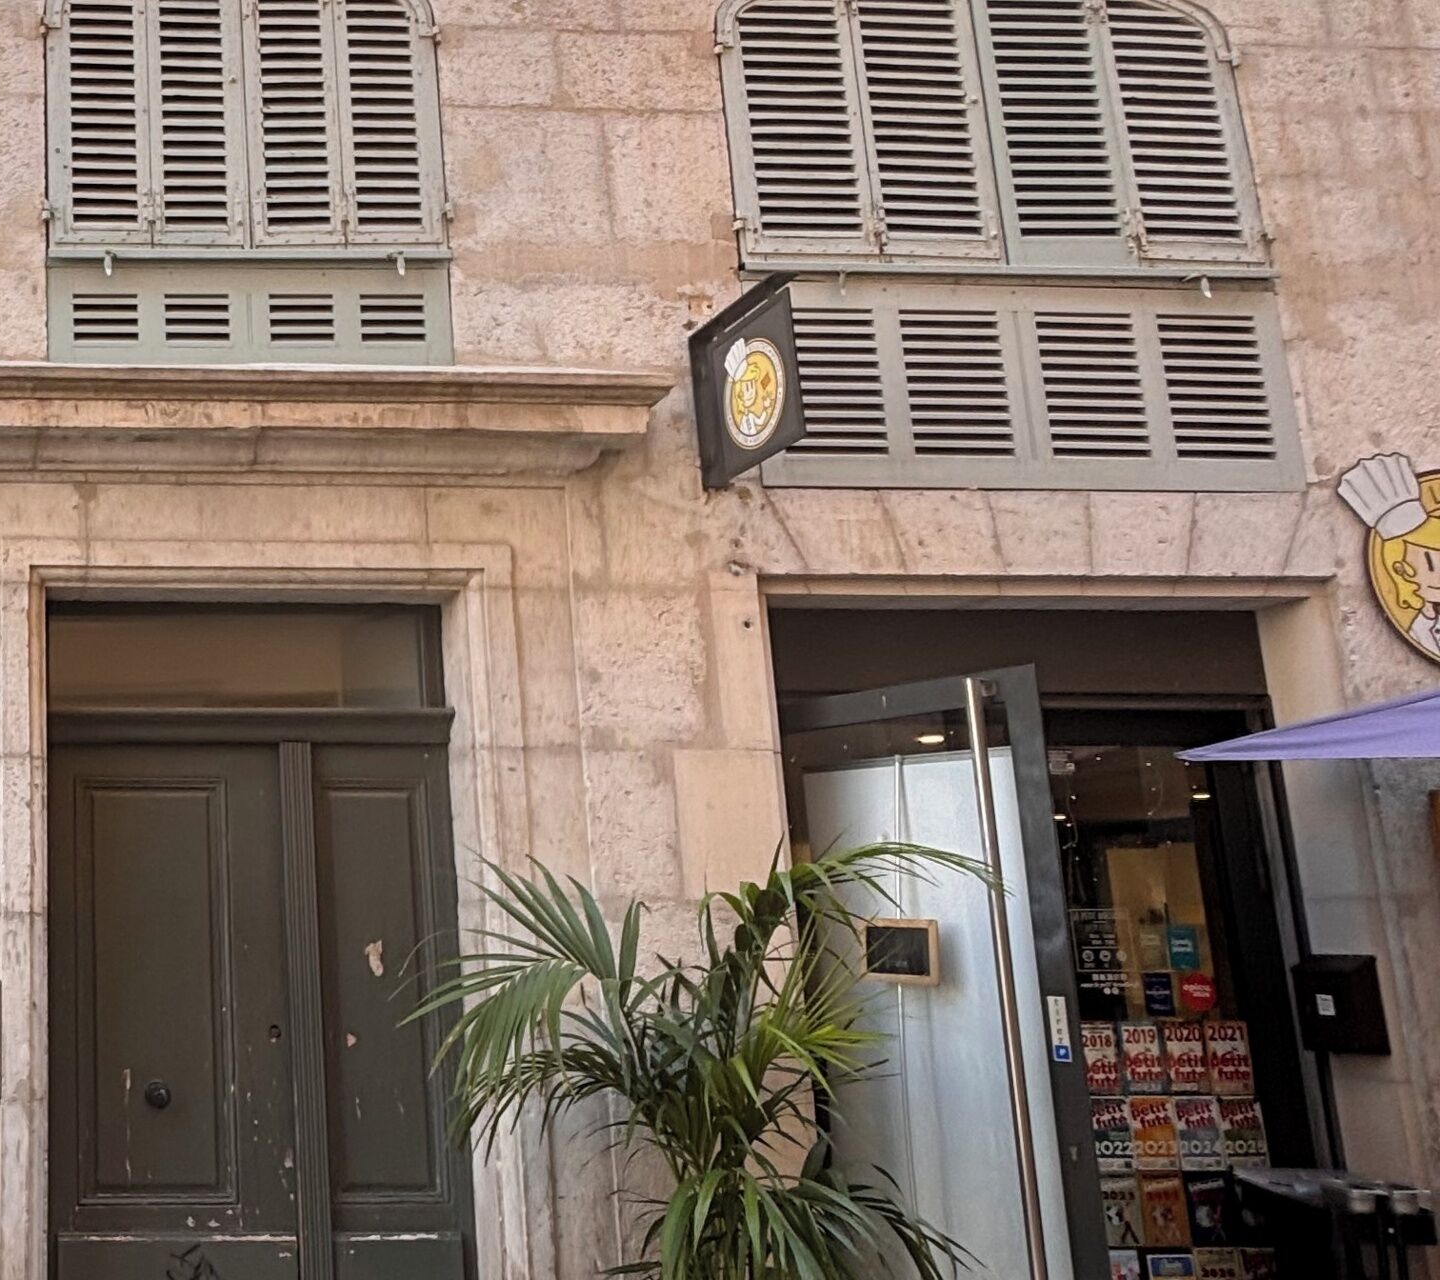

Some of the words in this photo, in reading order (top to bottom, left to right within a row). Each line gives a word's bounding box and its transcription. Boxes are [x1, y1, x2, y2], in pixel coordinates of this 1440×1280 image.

[1082, 1034, 1112, 1048] 2018
[1124, 1028, 1155, 1044] 2019
[1165, 1027, 1201, 1042] 2020
[1208, 1026, 1244, 1041] 2021
